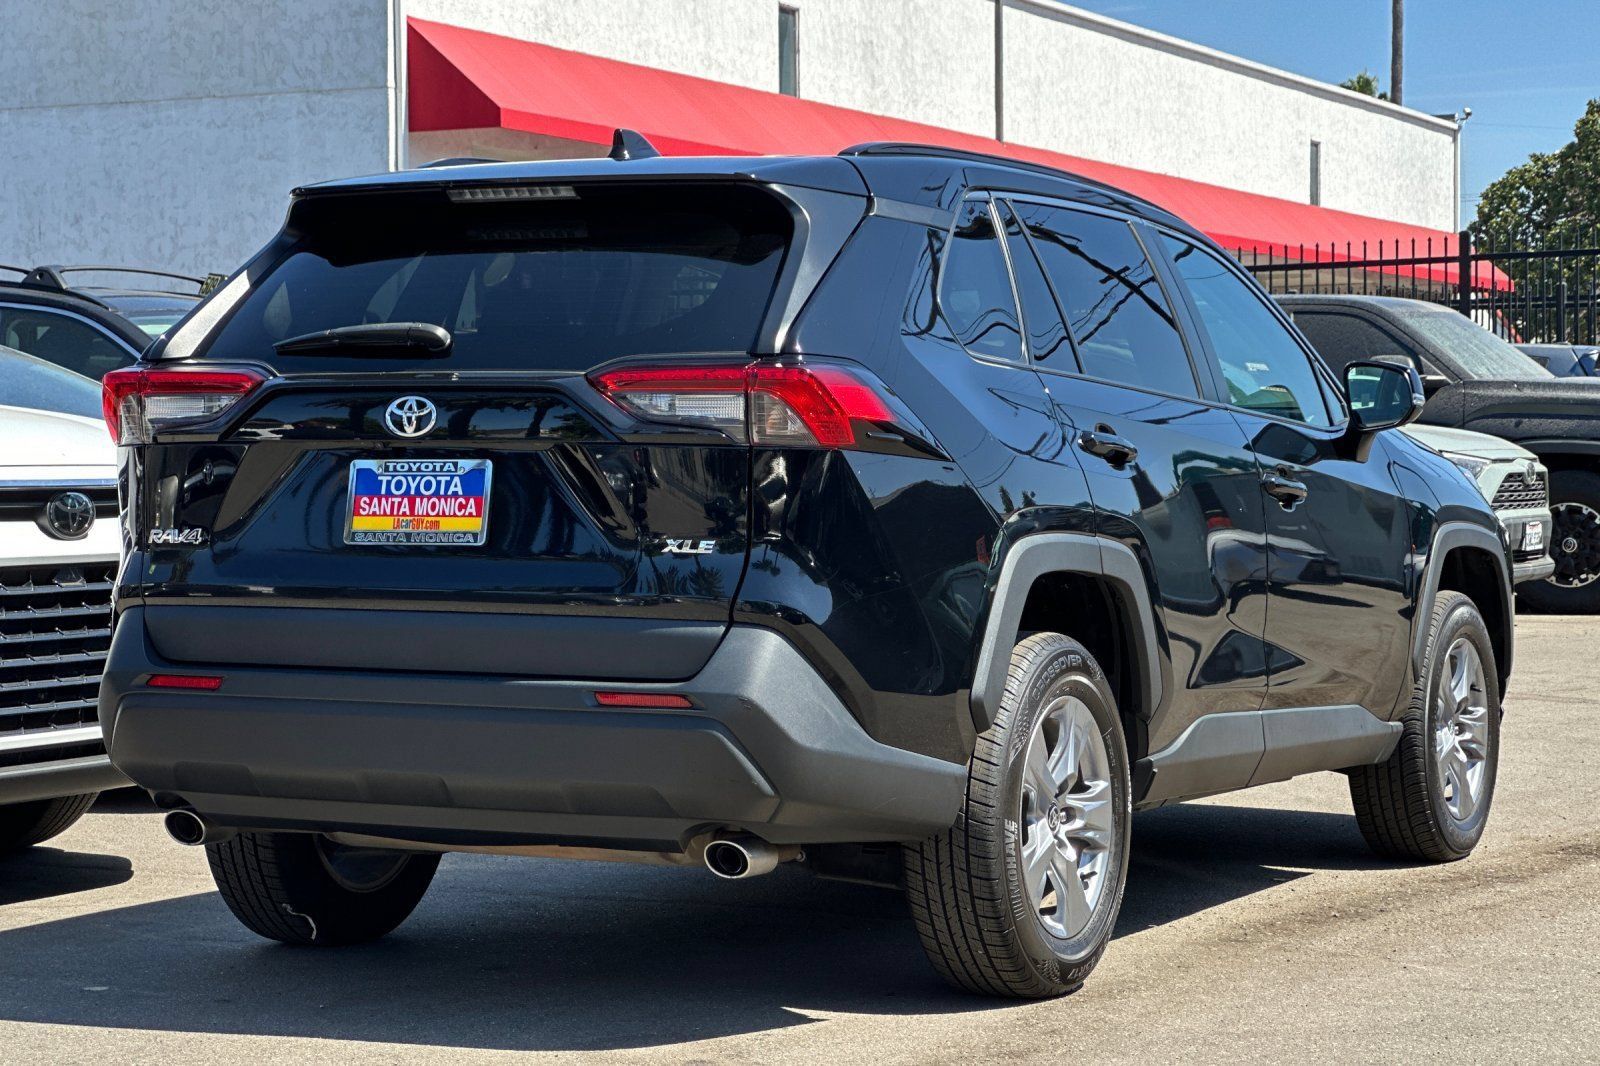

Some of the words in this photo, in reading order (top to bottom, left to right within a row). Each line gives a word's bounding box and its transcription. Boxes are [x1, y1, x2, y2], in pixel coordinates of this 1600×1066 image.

[386, 462, 456, 472] TOYOTA
[377, 475, 463, 495] TOYOTA
[359, 497, 410, 516] SANTA
[414, 497, 476, 516] MONICA
[148, 528, 202, 544] RAV4
[354, 531, 407, 543] SANTA
[410, 532, 475, 543] MONICA
[661, 539, 716, 554] XLE
[1032, 654, 1083, 701] CROSSOVER
[1004, 818, 1020, 898] MOHAVE
